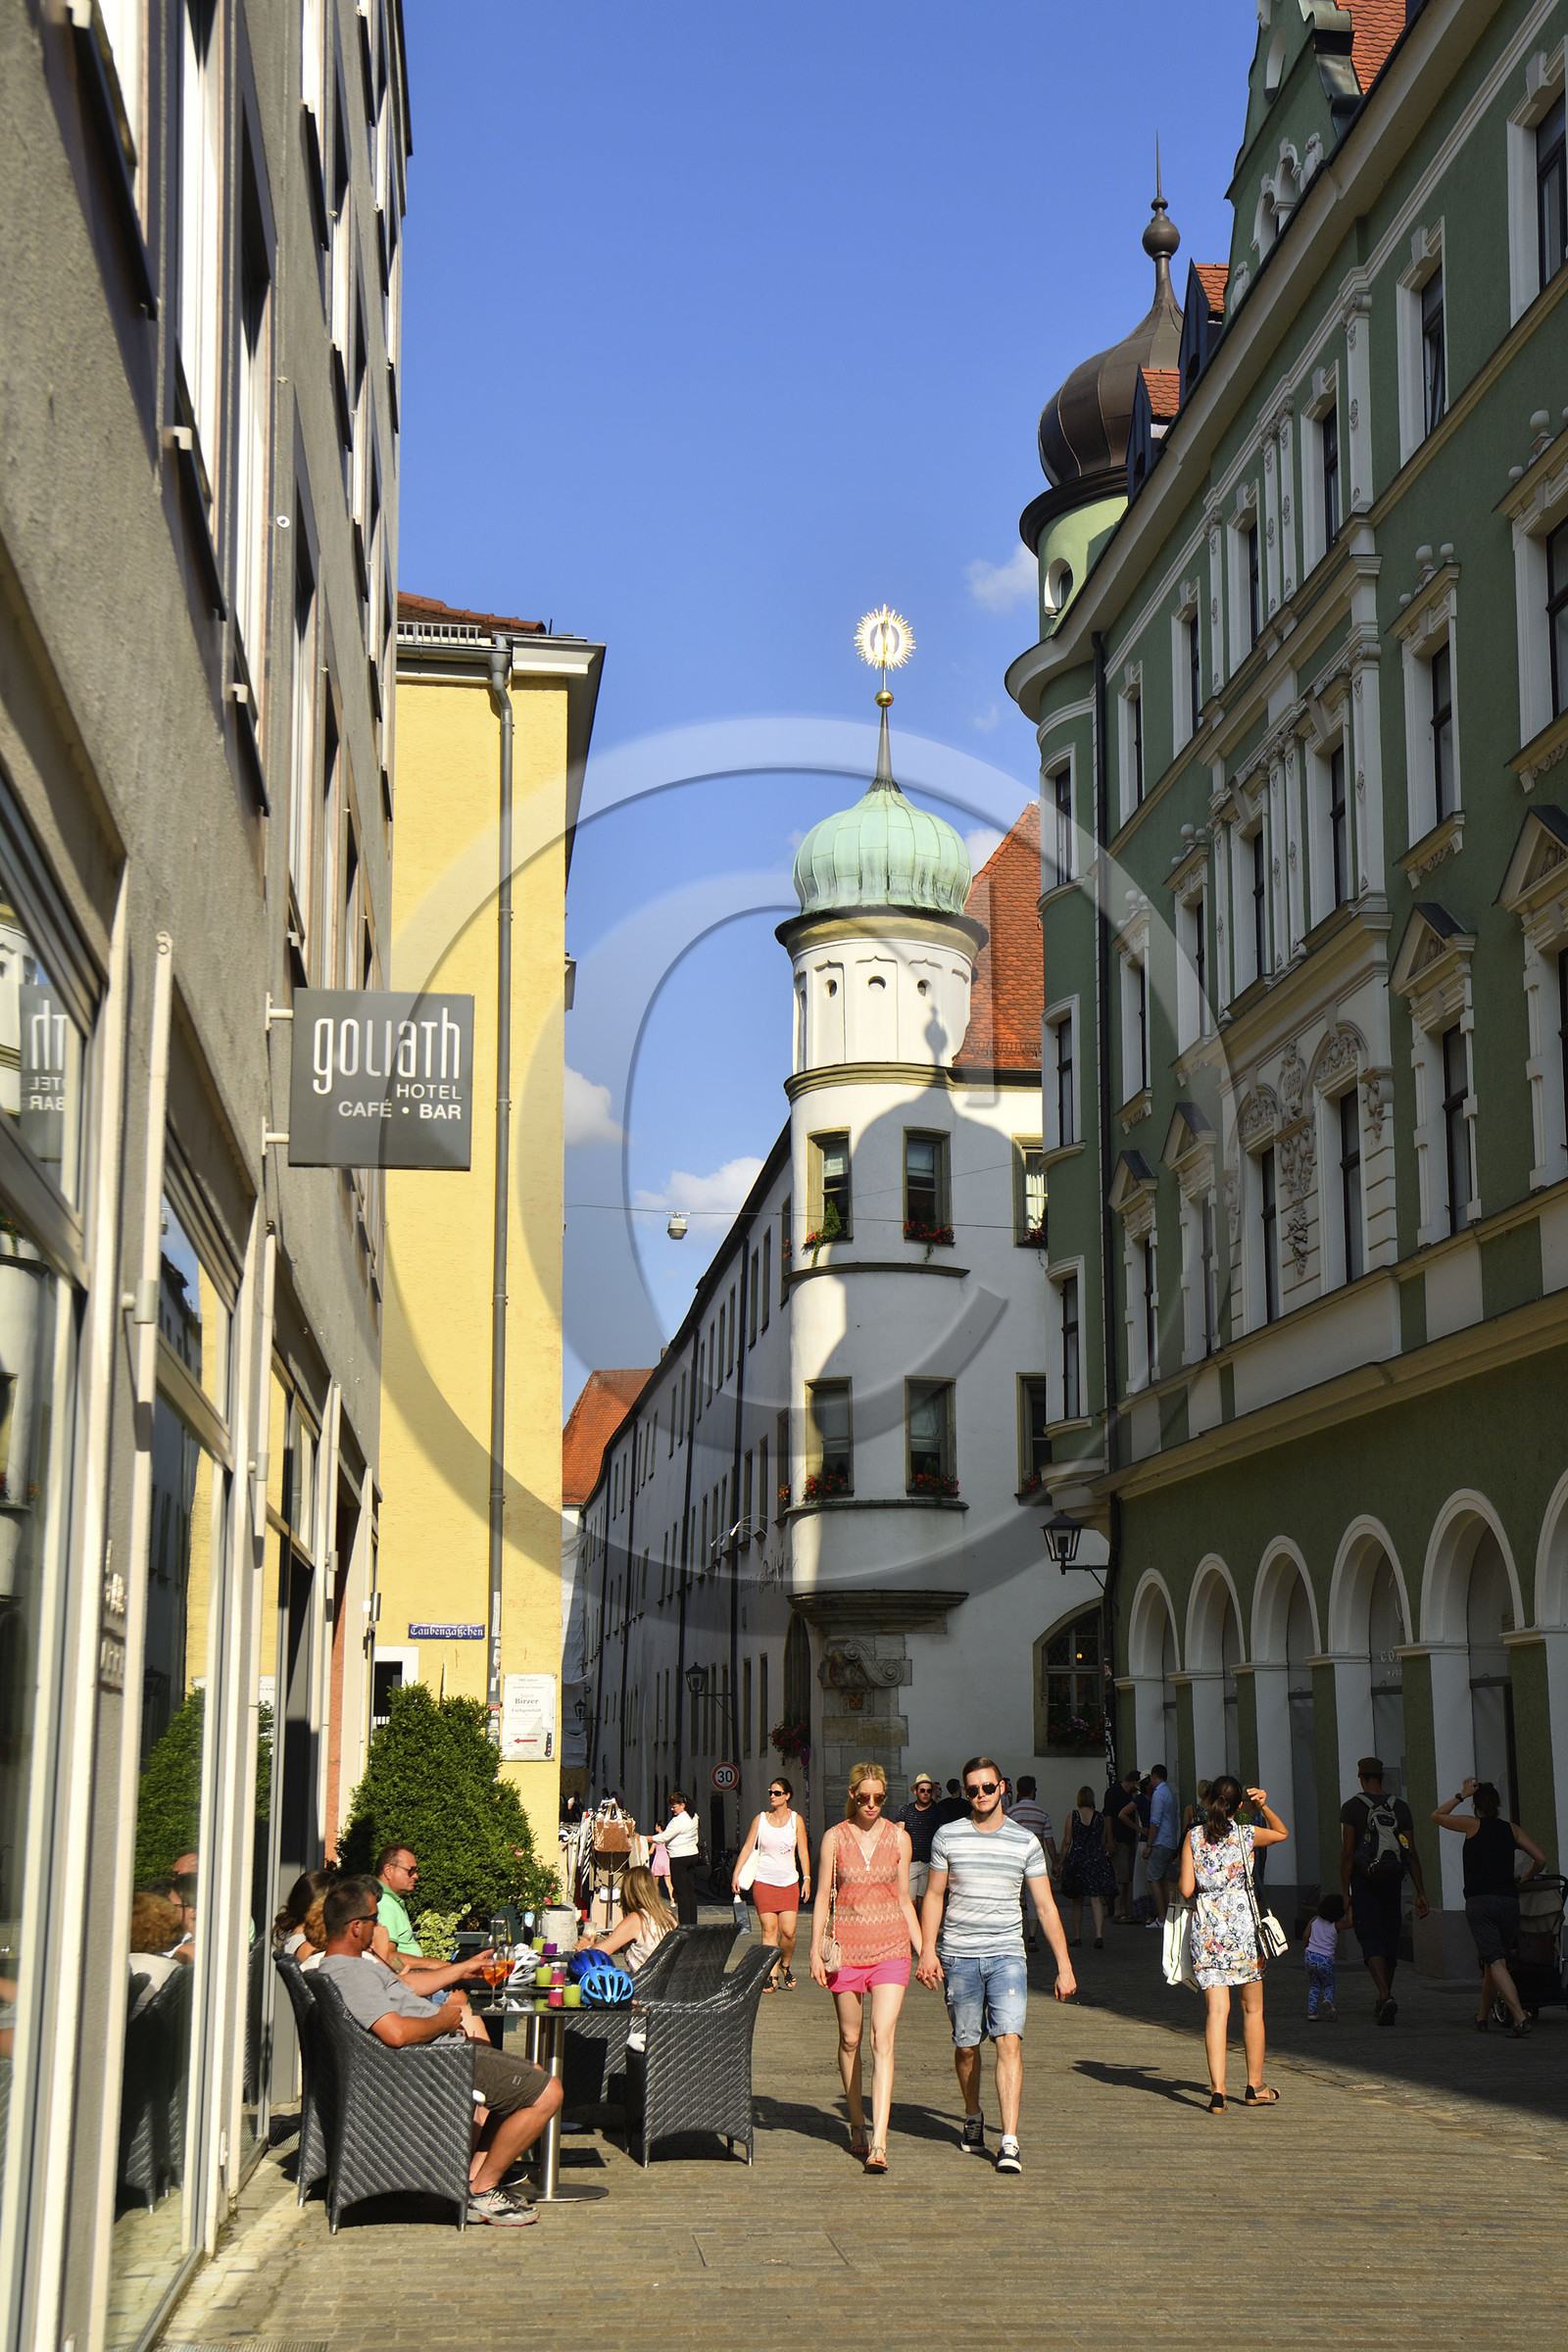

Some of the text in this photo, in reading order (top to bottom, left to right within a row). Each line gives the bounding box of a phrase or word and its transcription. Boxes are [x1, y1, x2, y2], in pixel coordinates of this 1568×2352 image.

[396, 1083, 463, 1101] HOTEL
[338, 1099, 462, 1120] CAFÉ BAR
[716, 1770, 733, 1784] 30
